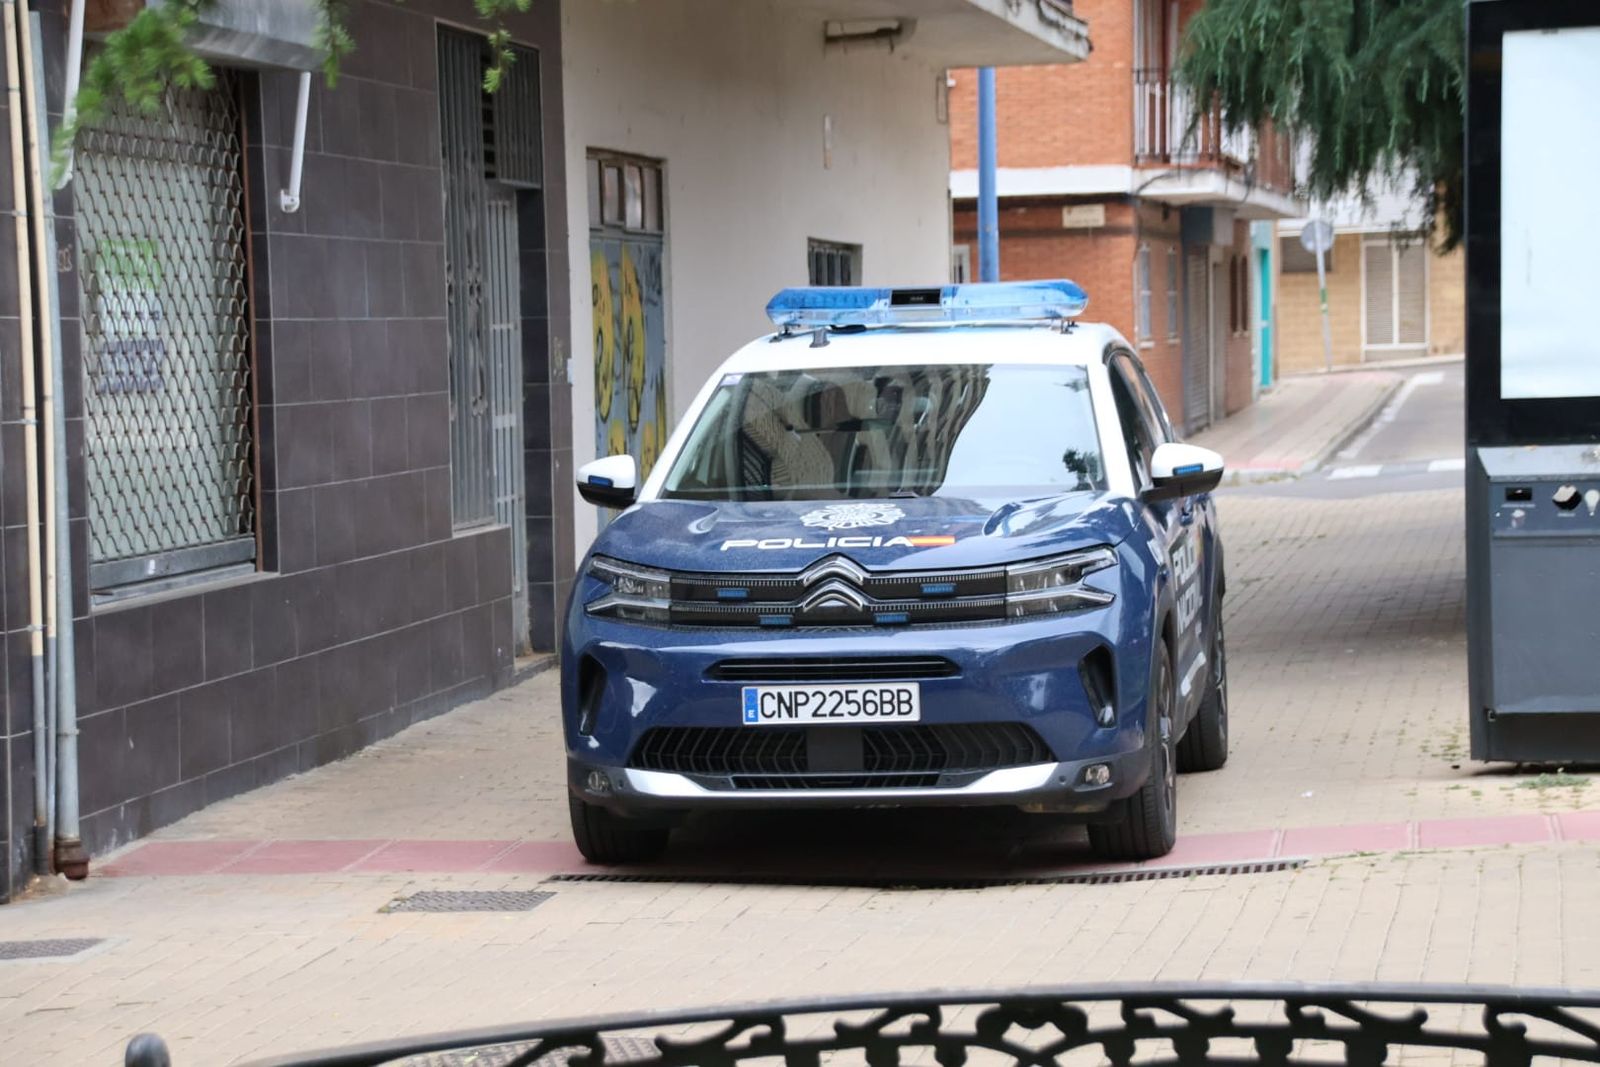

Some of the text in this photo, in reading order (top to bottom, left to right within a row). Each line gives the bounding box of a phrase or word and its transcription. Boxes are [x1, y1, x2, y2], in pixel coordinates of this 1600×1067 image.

[720, 536, 914, 551] POLICIA
[760, 688, 913, 719] CNP2256BB
[748, 710, 755, 718] E
